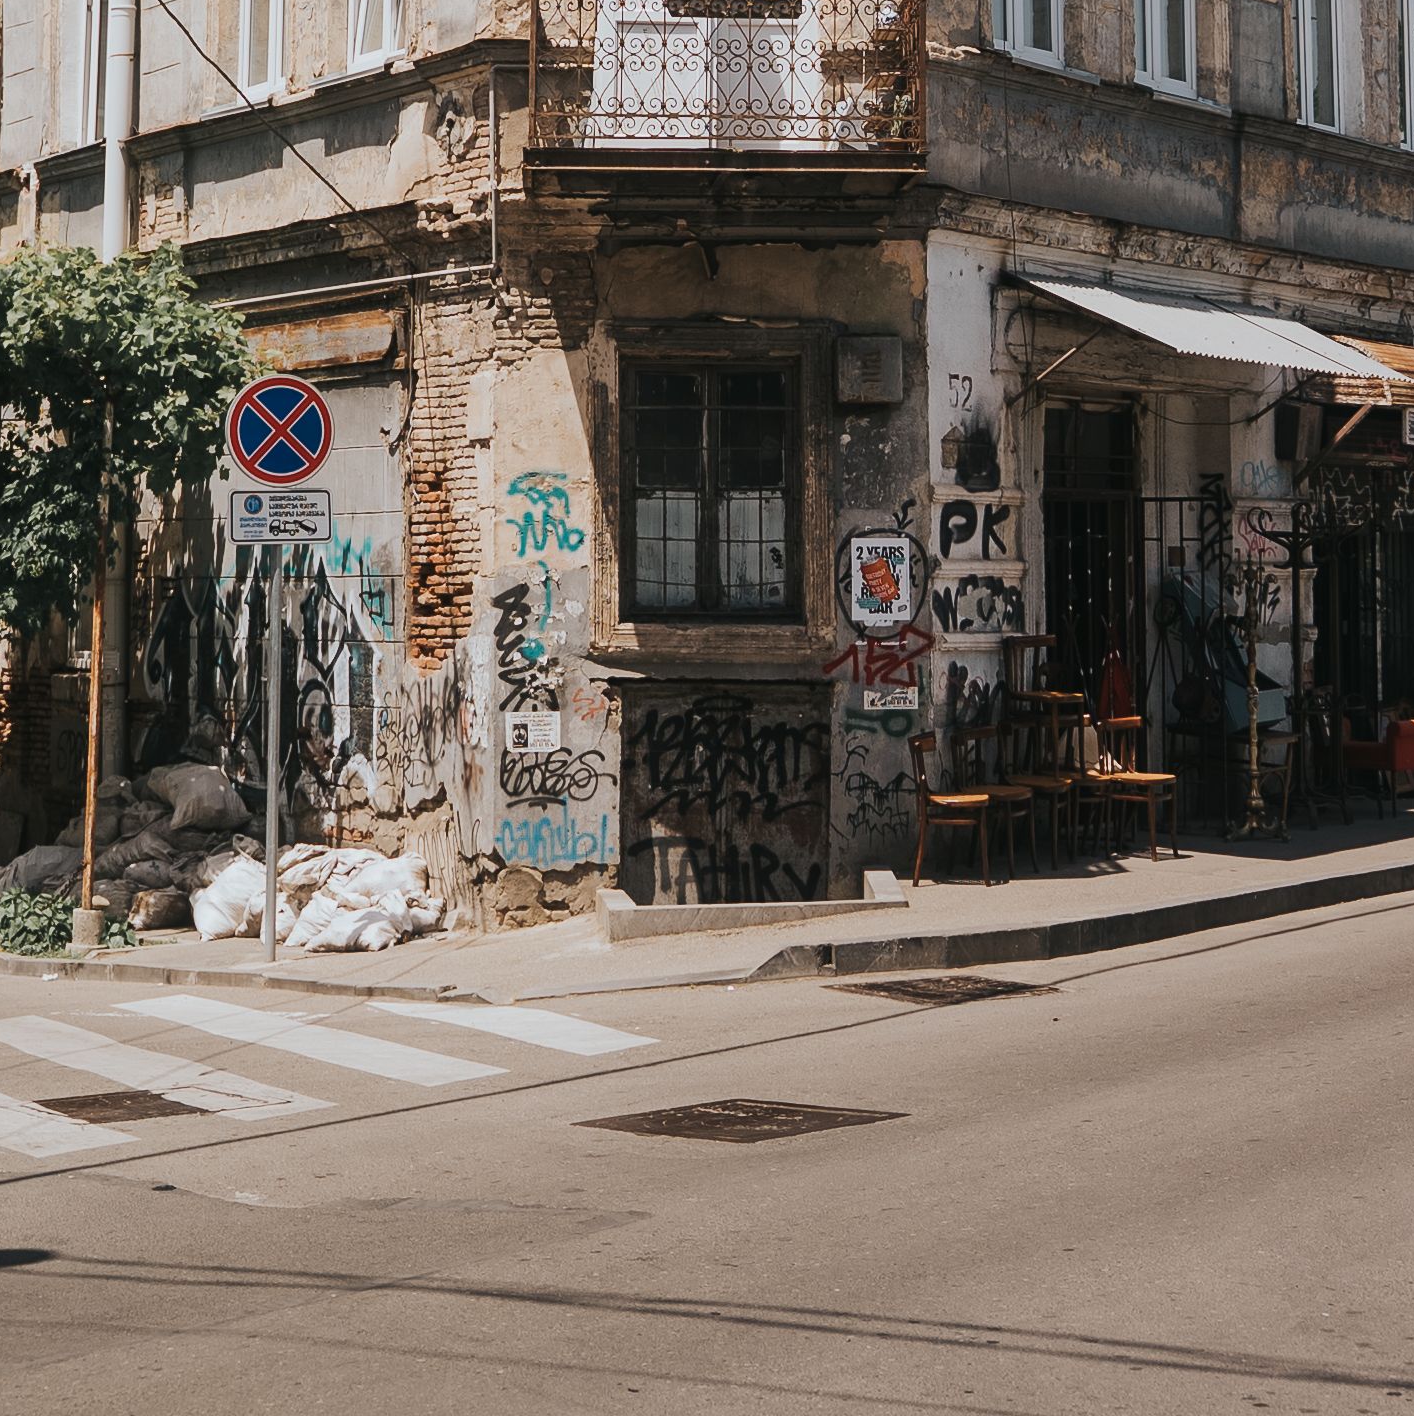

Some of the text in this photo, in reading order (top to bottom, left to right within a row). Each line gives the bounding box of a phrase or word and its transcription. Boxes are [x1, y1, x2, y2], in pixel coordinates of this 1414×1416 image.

[948, 372, 973, 413] 52
[856, 546, 904, 560] 2 YEARS
